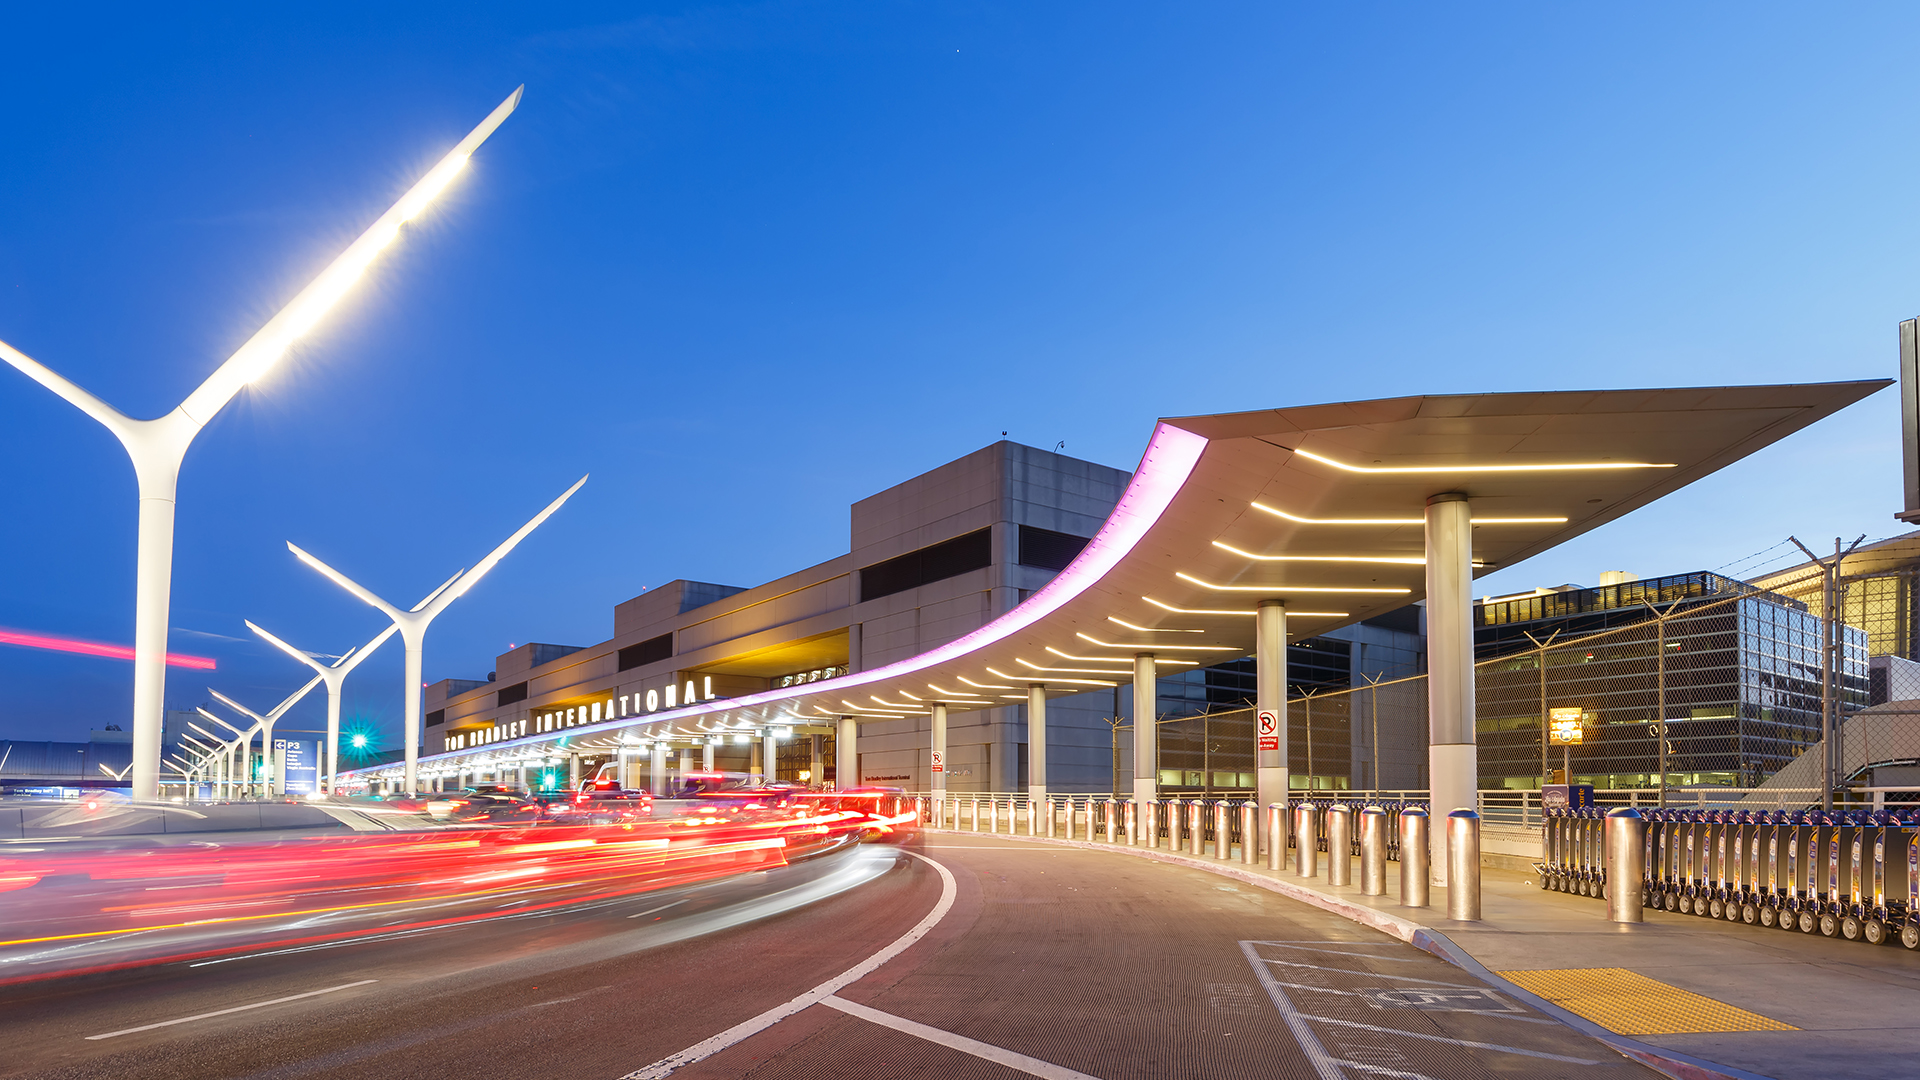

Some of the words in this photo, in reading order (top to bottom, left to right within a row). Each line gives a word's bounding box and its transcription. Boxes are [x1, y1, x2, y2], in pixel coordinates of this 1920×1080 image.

[444, 734, 465, 752] TOM
[470, 719, 527, 746] BRADLEY
[536, 675, 716, 734] INTERNATIONAL
